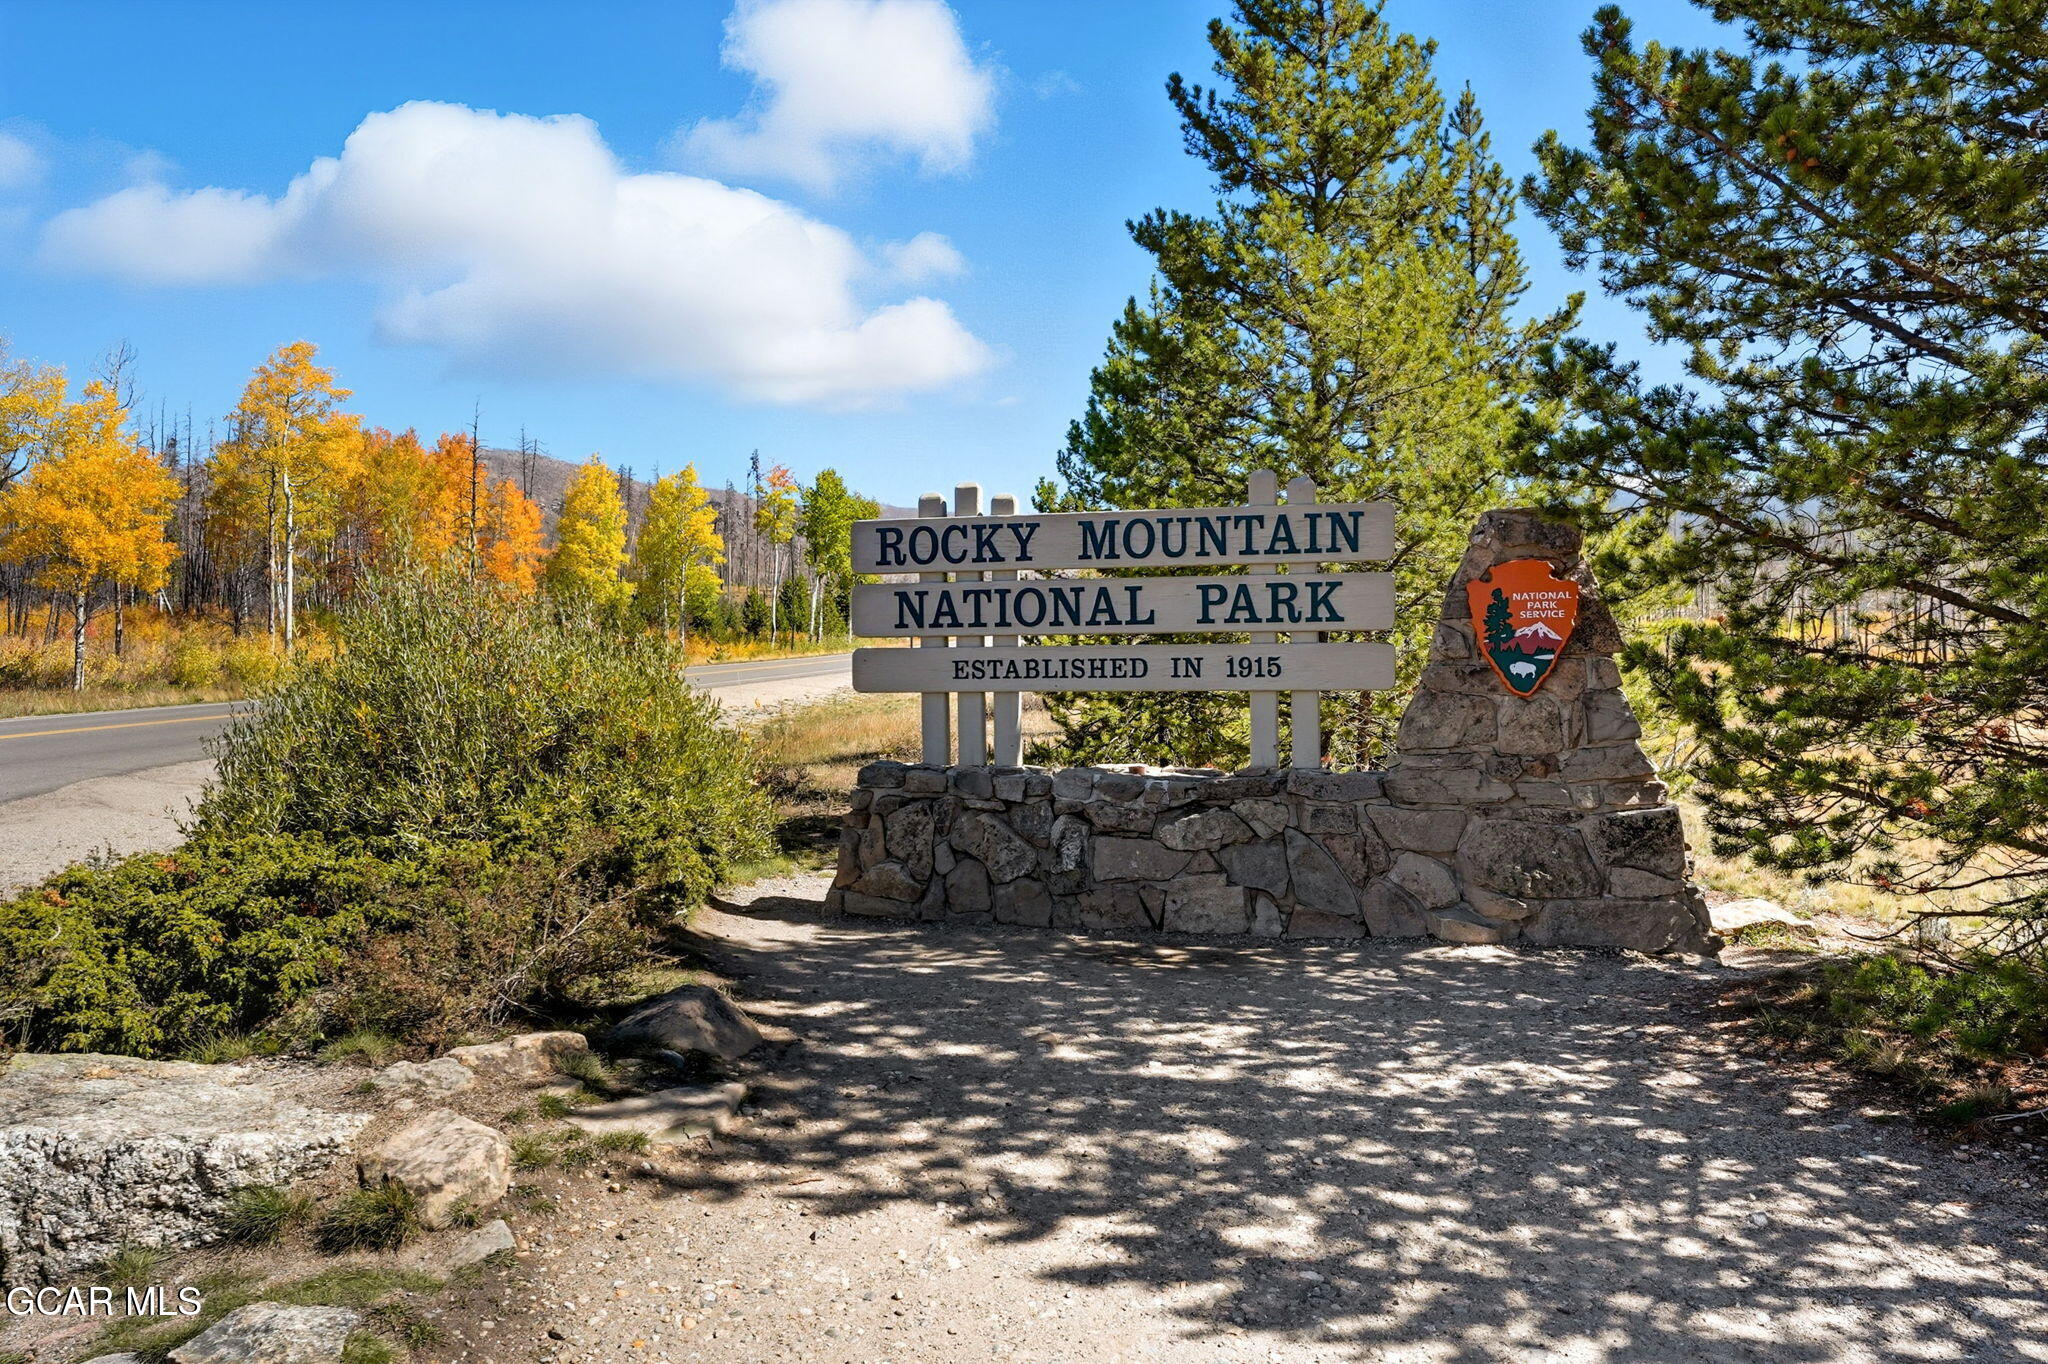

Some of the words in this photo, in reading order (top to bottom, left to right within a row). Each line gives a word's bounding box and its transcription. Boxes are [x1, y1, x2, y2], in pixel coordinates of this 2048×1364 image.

[875, 522, 1040, 566] ROCKY
[1077, 511, 1365, 560] MOUNTAIN
[1512, 591, 1572, 600] NATIONAL
[893, 584, 1155, 629] NATIONAL
[1196, 580, 1345, 624] PARK
[1527, 601, 1557, 609] PARK
[1519, 610, 1565, 618] SERVICE
[952, 657, 1149, 680] ESTABLISHED
[1170, 656, 1204, 678] IN
[1226, 656, 1282, 678] 1915
